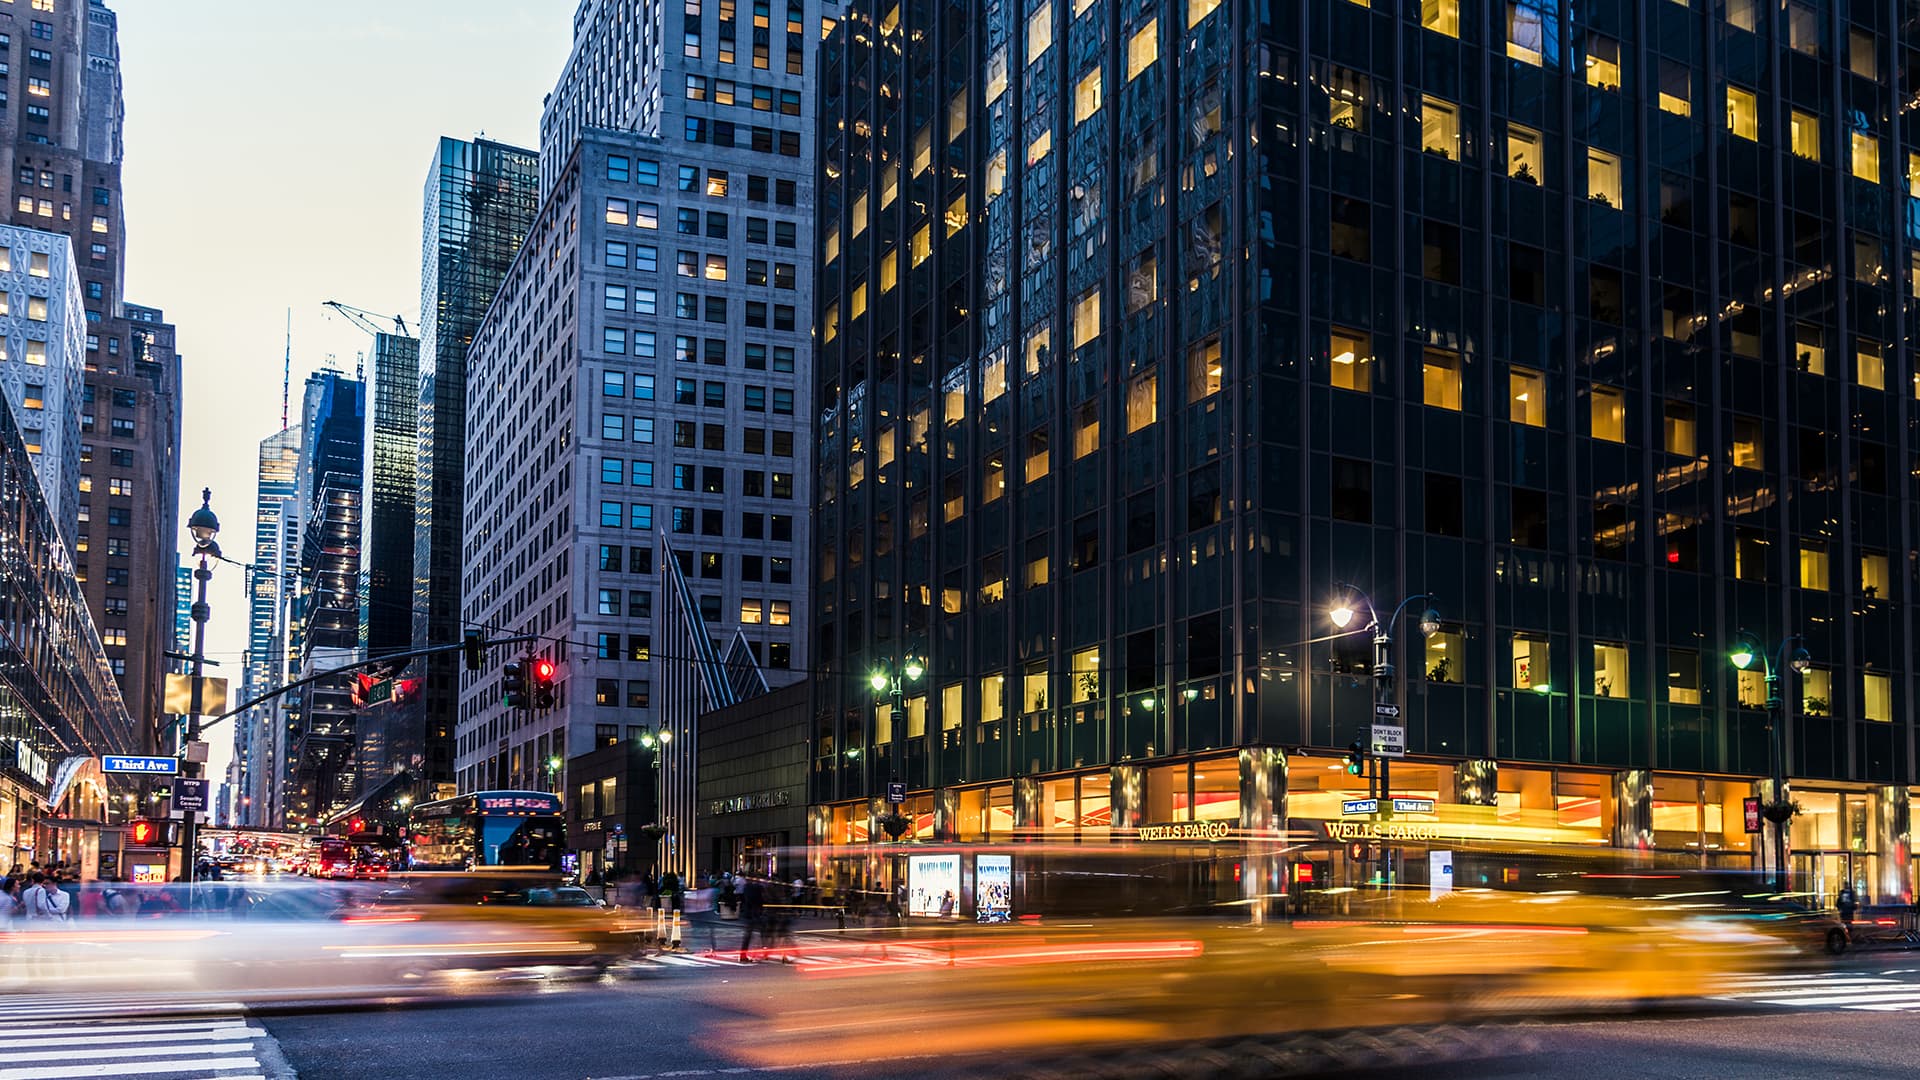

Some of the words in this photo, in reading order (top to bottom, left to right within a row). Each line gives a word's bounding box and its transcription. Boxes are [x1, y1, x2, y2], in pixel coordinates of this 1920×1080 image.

[112, 759, 145, 770] Third
[147, 760, 169, 771] Ave
[179, 795, 202, 803] Security
[482, 798, 512, 808] THE
[514, 798, 551, 809] RIDE
[1397, 802, 1416, 811] Third
[1416, 803, 1430, 811] Ave
[1138, 825, 1182, 841] WELLS
[1183, 822, 1230, 839] FARGO
[1324, 822, 1382, 839] WELLS
[1388, 825, 1440, 840] FARGO
